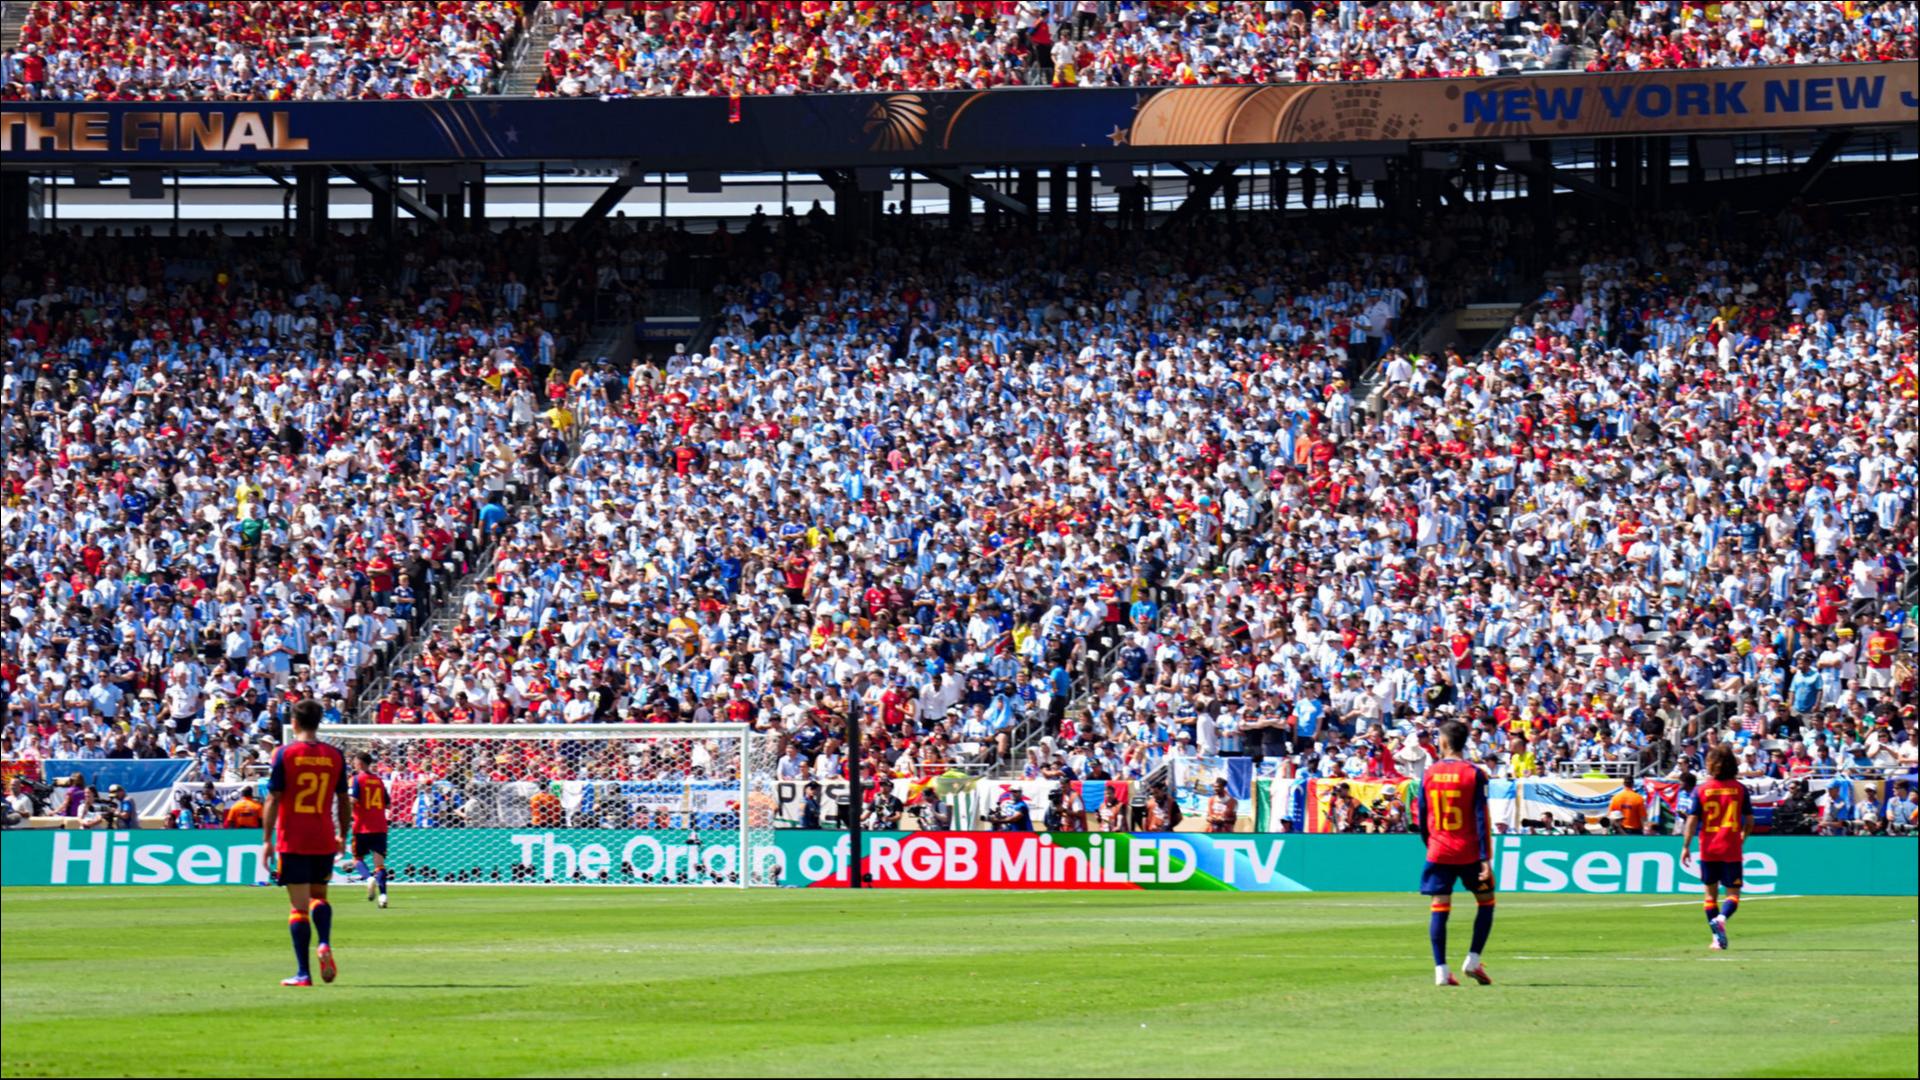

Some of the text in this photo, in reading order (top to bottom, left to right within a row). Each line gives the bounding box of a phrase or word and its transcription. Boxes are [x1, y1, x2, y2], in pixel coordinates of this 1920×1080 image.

[1463, 87, 1584, 123] NEW
[1601, 80, 1748, 118] YORK
[1763, 75, 1887, 113] NEW
[1, 112, 309, 151] THE FINAL
[294, 772, 330, 813] 21
[364, 786, 382, 810] 14
[1430, 789, 1462, 831] 15
[1703, 800, 1738, 832] 24
[51, 831, 362, 884] Hisen
[511, 832, 1285, 885] The Orign of RGB MiniLED TV
[1491, 836, 1778, 893] isene
